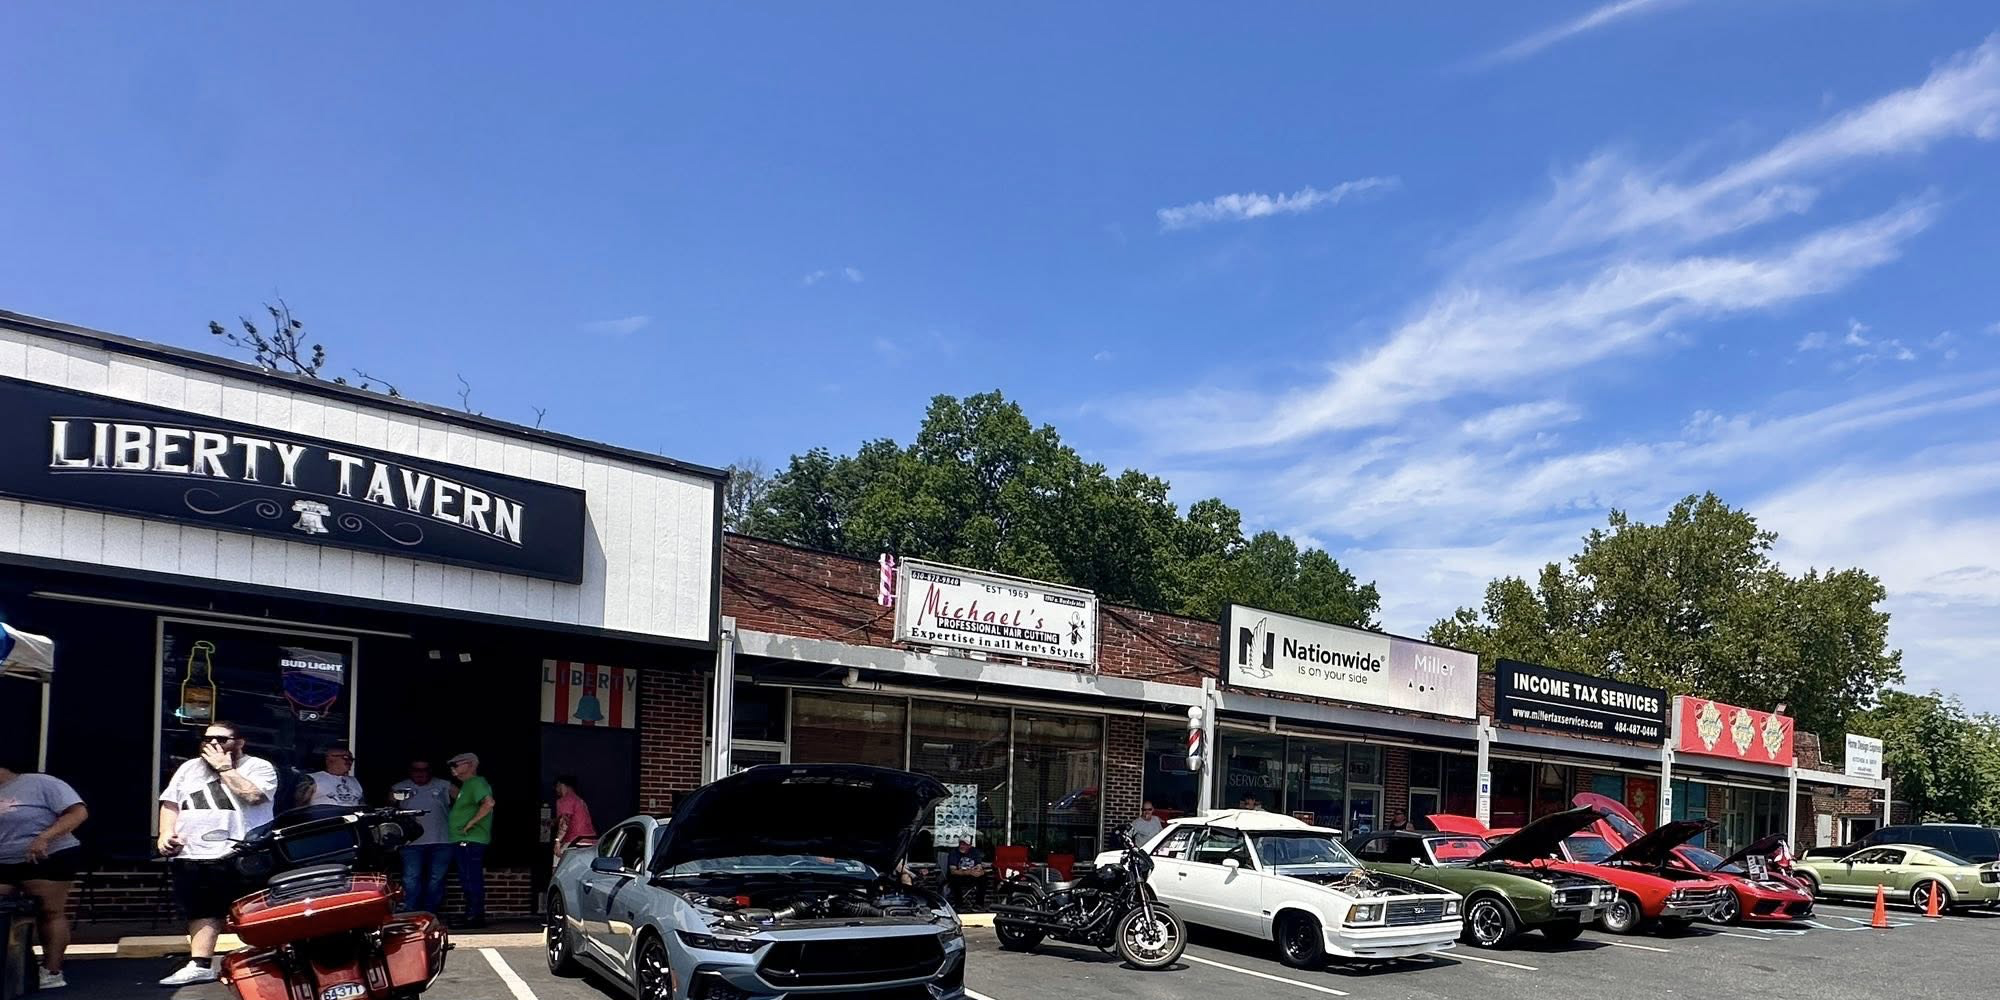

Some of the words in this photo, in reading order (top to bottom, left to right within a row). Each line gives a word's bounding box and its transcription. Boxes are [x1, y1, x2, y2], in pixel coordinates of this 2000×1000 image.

[50, 420, 307, 487] LIBERTY
[328, 452, 525, 543] TAVERN
[917, 582, 1044, 630] Michael's
[1008, 589, 1029, 599] 1969
[911, 627, 975, 646] Expertise
[979, 637, 991, 647] in
[994, 639, 1011, 650] all
[1014, 640, 1046, 654] Men's
[1050, 646, 1085, 659] Styles
[938, 617, 1001, 636] PROFESSIONAL
[1003, 627, 1021, 638] HAIR
[1024, 630, 1058, 644] CUTTING
[280, 659, 307, 668] BUD
[307, 661, 343, 672] LIGHT
[1282, 637, 1381, 673] Nationwide
[1414, 653, 1456, 676] Miller
[543, 666, 636, 692] LIBERTY
[1298, 664, 1306, 676] is
[1309, 668, 1322, 678] on
[1324, 670, 1345, 682] your
[1349, 671, 1368, 685] side
[1513, 672, 1570, 698] INCOME
[1573, 683, 1598, 704] TAX
[1601, 689, 1659, 714] SERVICES
[1512, 707, 1604, 730] www.millertaxservices.com
[1614, 721, 1658, 738] 484-487-0444
